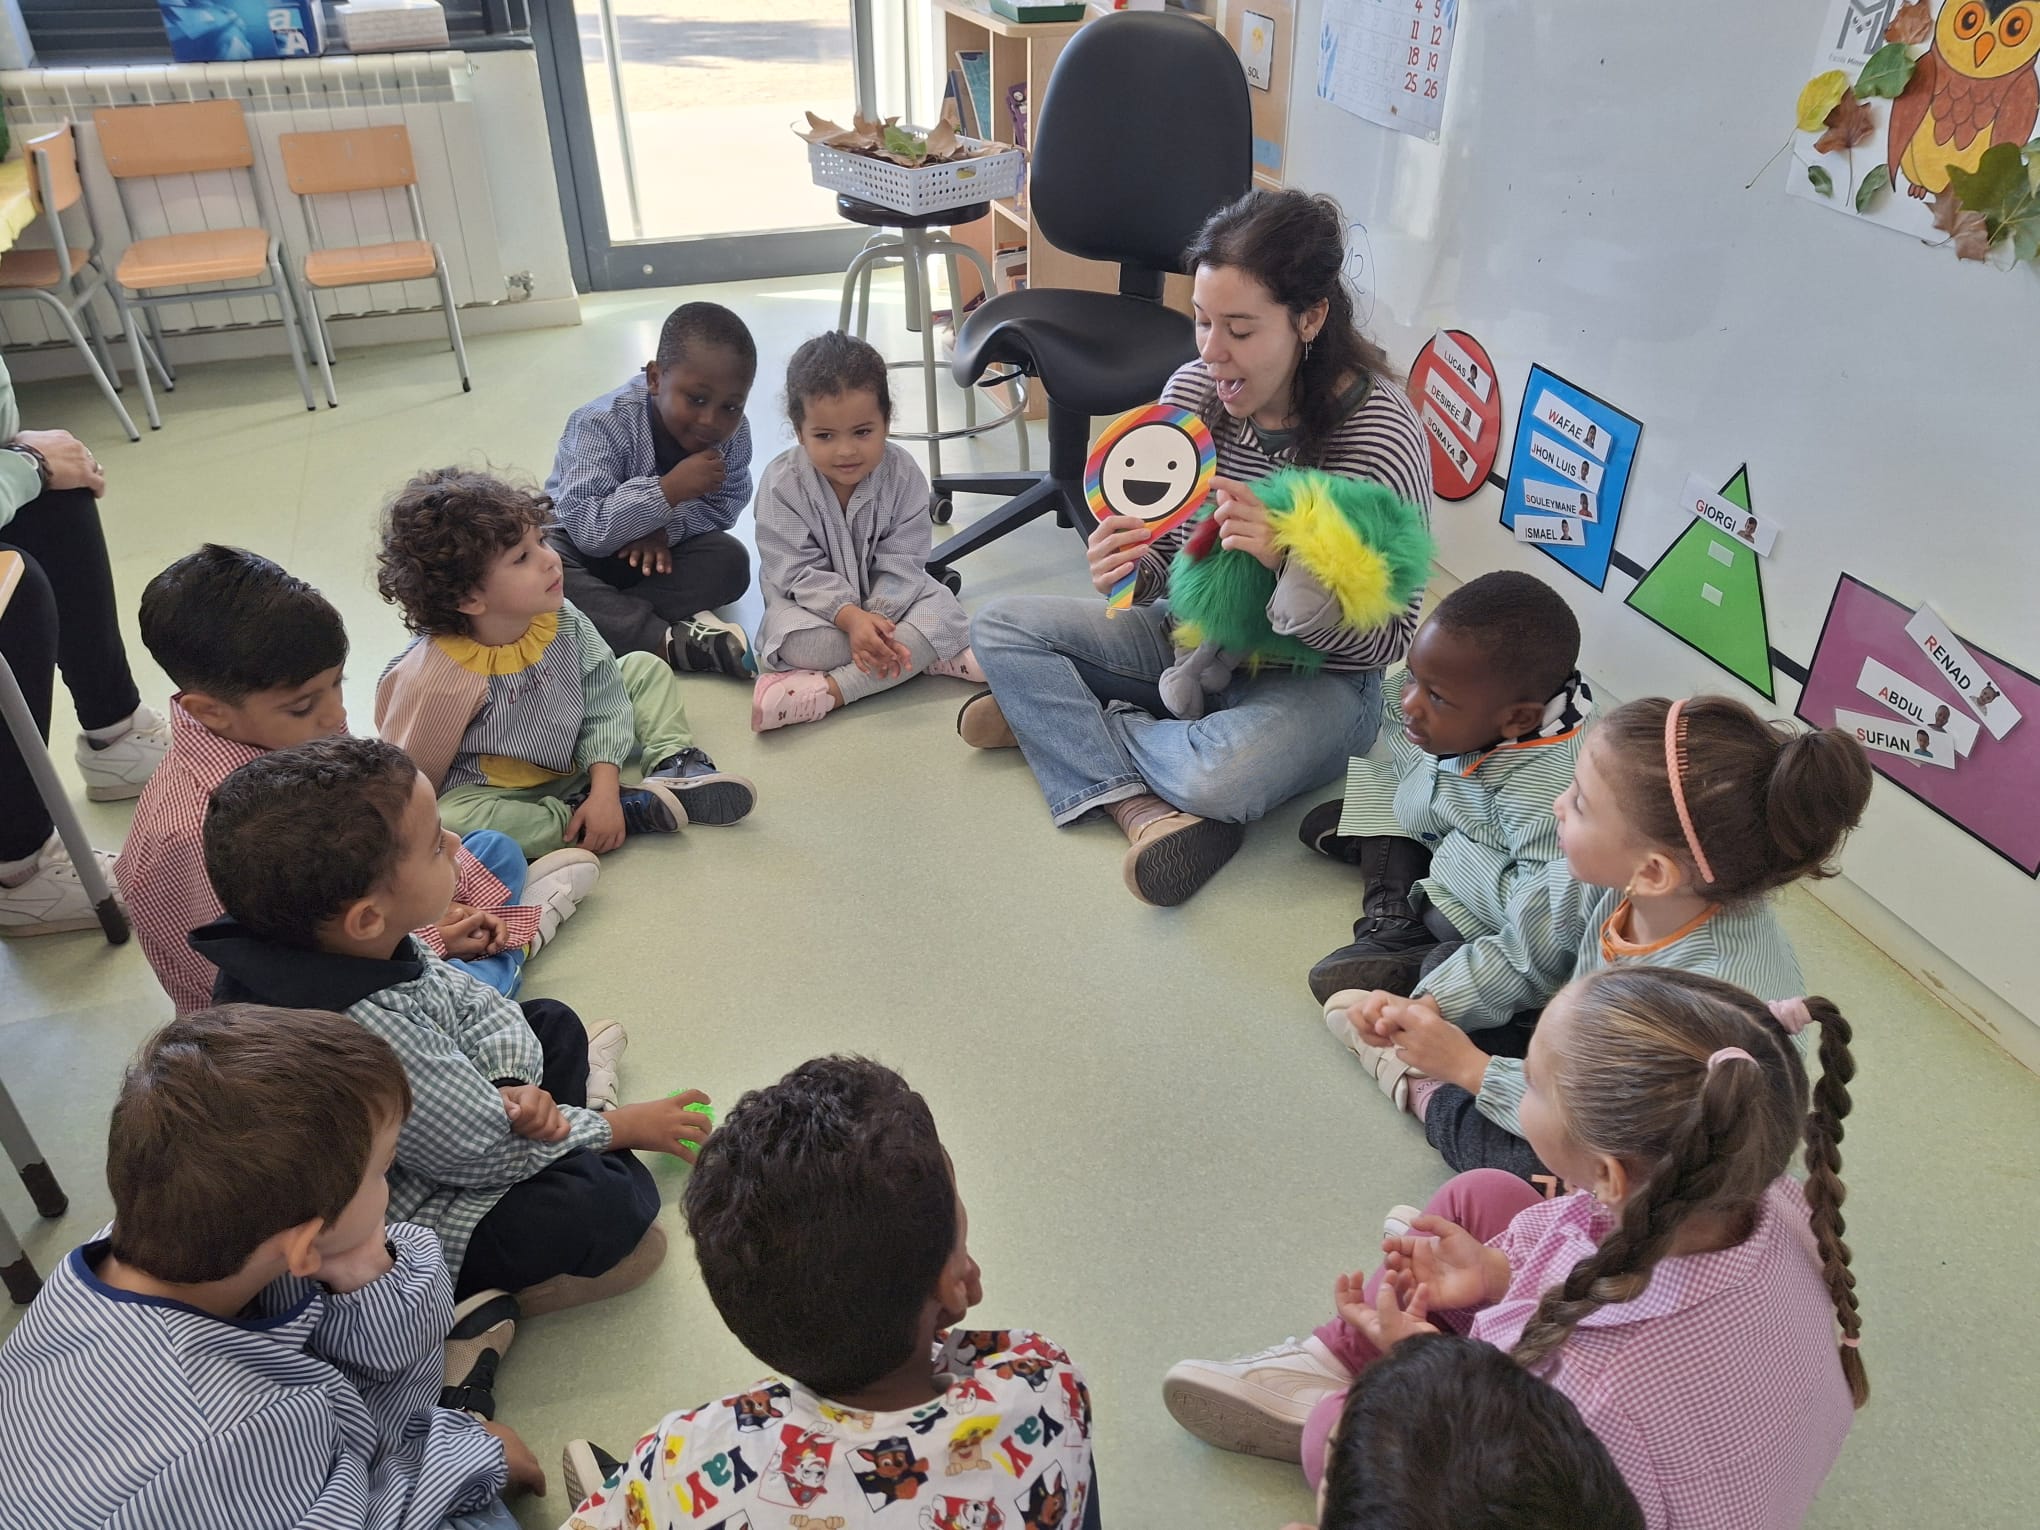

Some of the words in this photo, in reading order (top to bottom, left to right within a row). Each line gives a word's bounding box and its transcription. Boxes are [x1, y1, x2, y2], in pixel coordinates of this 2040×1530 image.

[1434, 0, 1441, 18] 5
[1411, 20, 1420, 40] 11
[1430, 25, 1442, 45] 12
[1407, 46, 1420, 66] 18
[1426, 52, 1439, 72] 19
[1248, 66, 1260, 79] SOL
[1404, 72, 1418, 93] 25
[1423, 78, 1438, 99] 26
[1443, 351, 1467, 377] LUCAS
[1431, 385, 1462, 421] DESIRÉE
[1427, 416, 1456, 458] SOMAYA
[1548, 408, 1583, 440] WAFAE
[1531, 443, 1555, 465] JHON
[1556, 456, 1577, 477] LUIS
[1526, 494, 1577, 514] SOULEYMANE
[1695, 499, 1737, 532] GIORGI
[1525, 527, 1558, 541] ISMAEL
[1924, 635, 1972, 691] RENAD
[1878, 686, 1925, 723] ABDUL
[1856, 727, 1911, 753] SUFIAN
